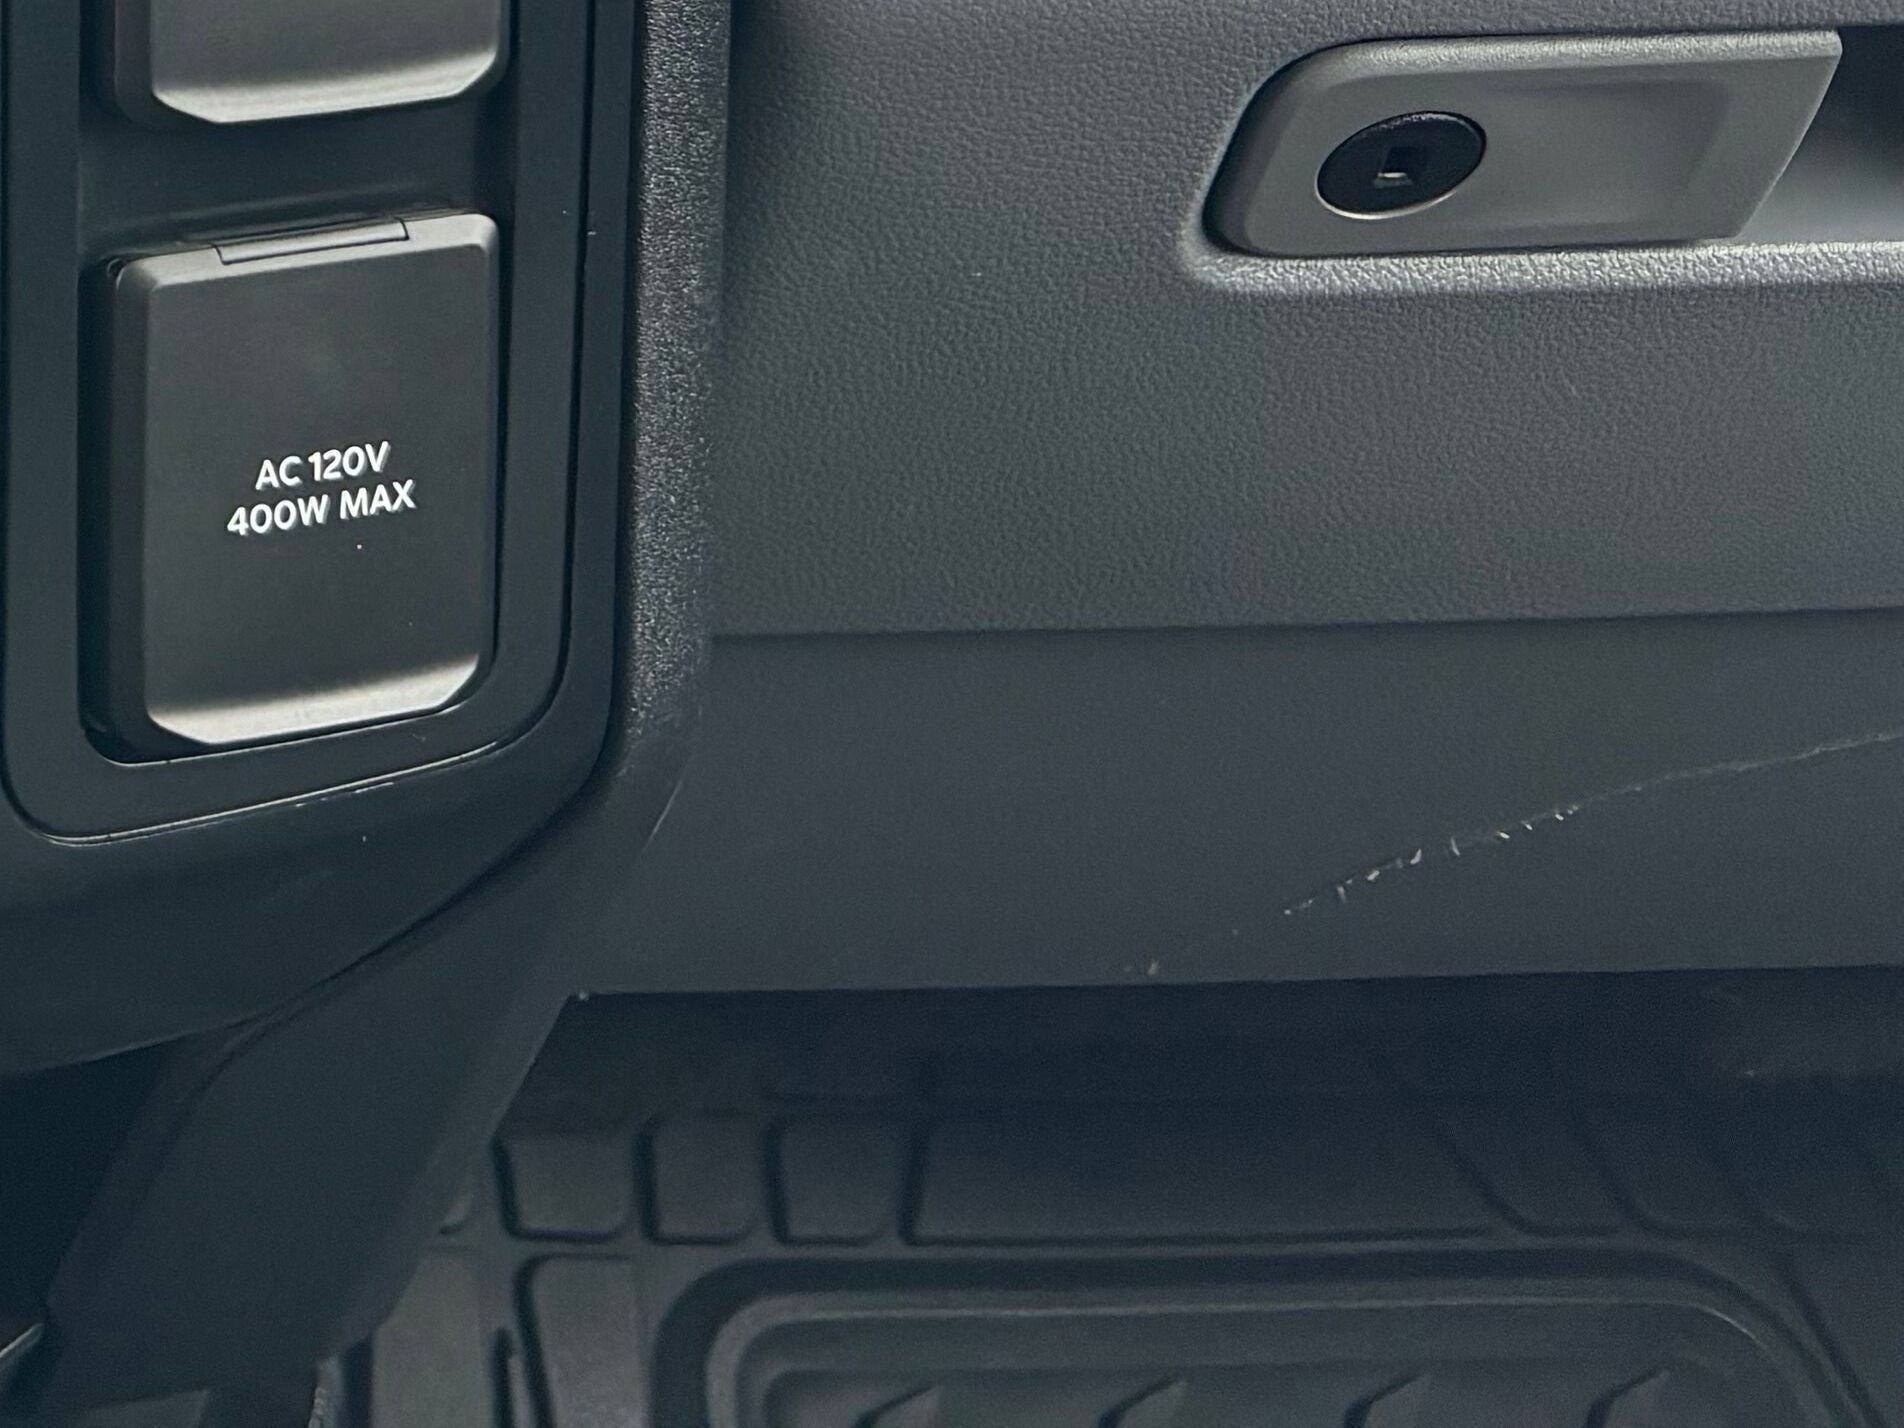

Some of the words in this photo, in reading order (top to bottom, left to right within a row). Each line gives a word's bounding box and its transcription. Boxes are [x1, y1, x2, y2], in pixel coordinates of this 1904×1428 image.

[255, 455, 302, 490] AC
[307, 440, 389, 482] 120V
[227, 494, 329, 536] 400W
[339, 479, 416, 520] MAX
